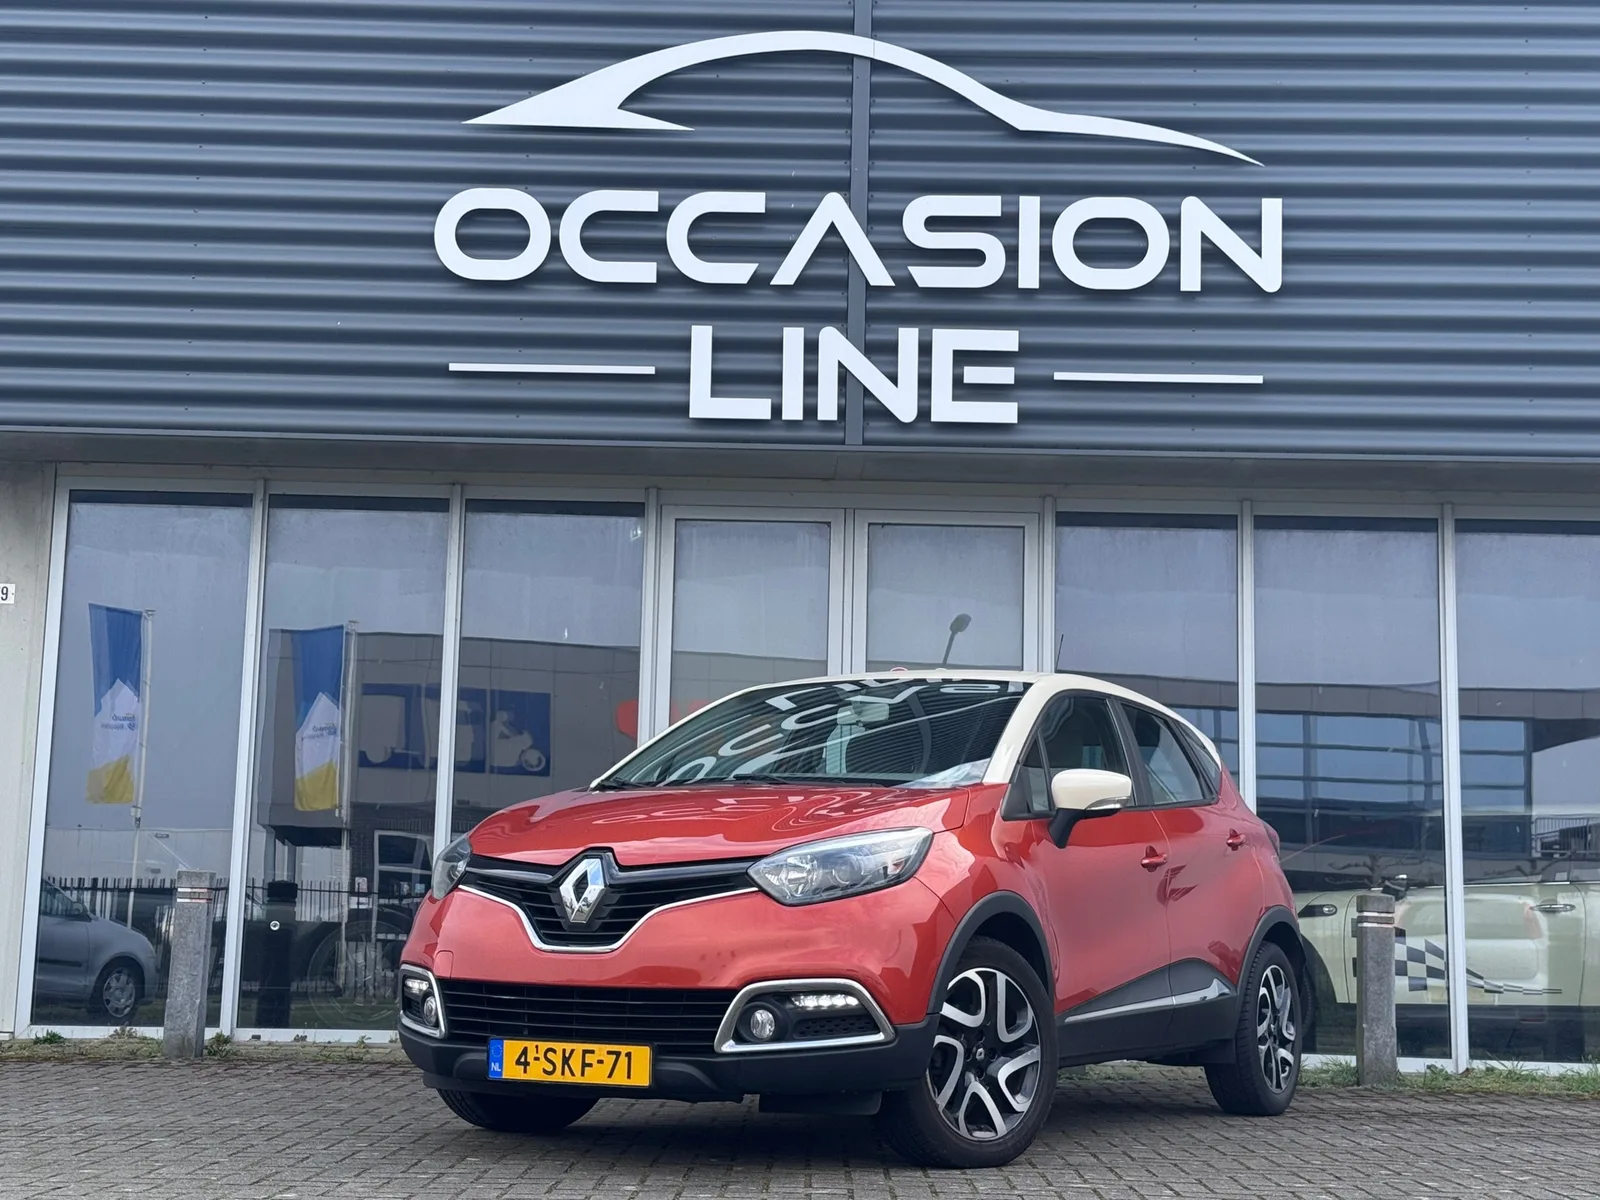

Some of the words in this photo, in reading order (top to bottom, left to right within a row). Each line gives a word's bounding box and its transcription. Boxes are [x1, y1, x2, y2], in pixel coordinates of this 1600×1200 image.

[434, 187, 1283, 293] OCCASION
[689, 325, 1020, 424] LINE
[491, 1062, 501, 1071] NL
